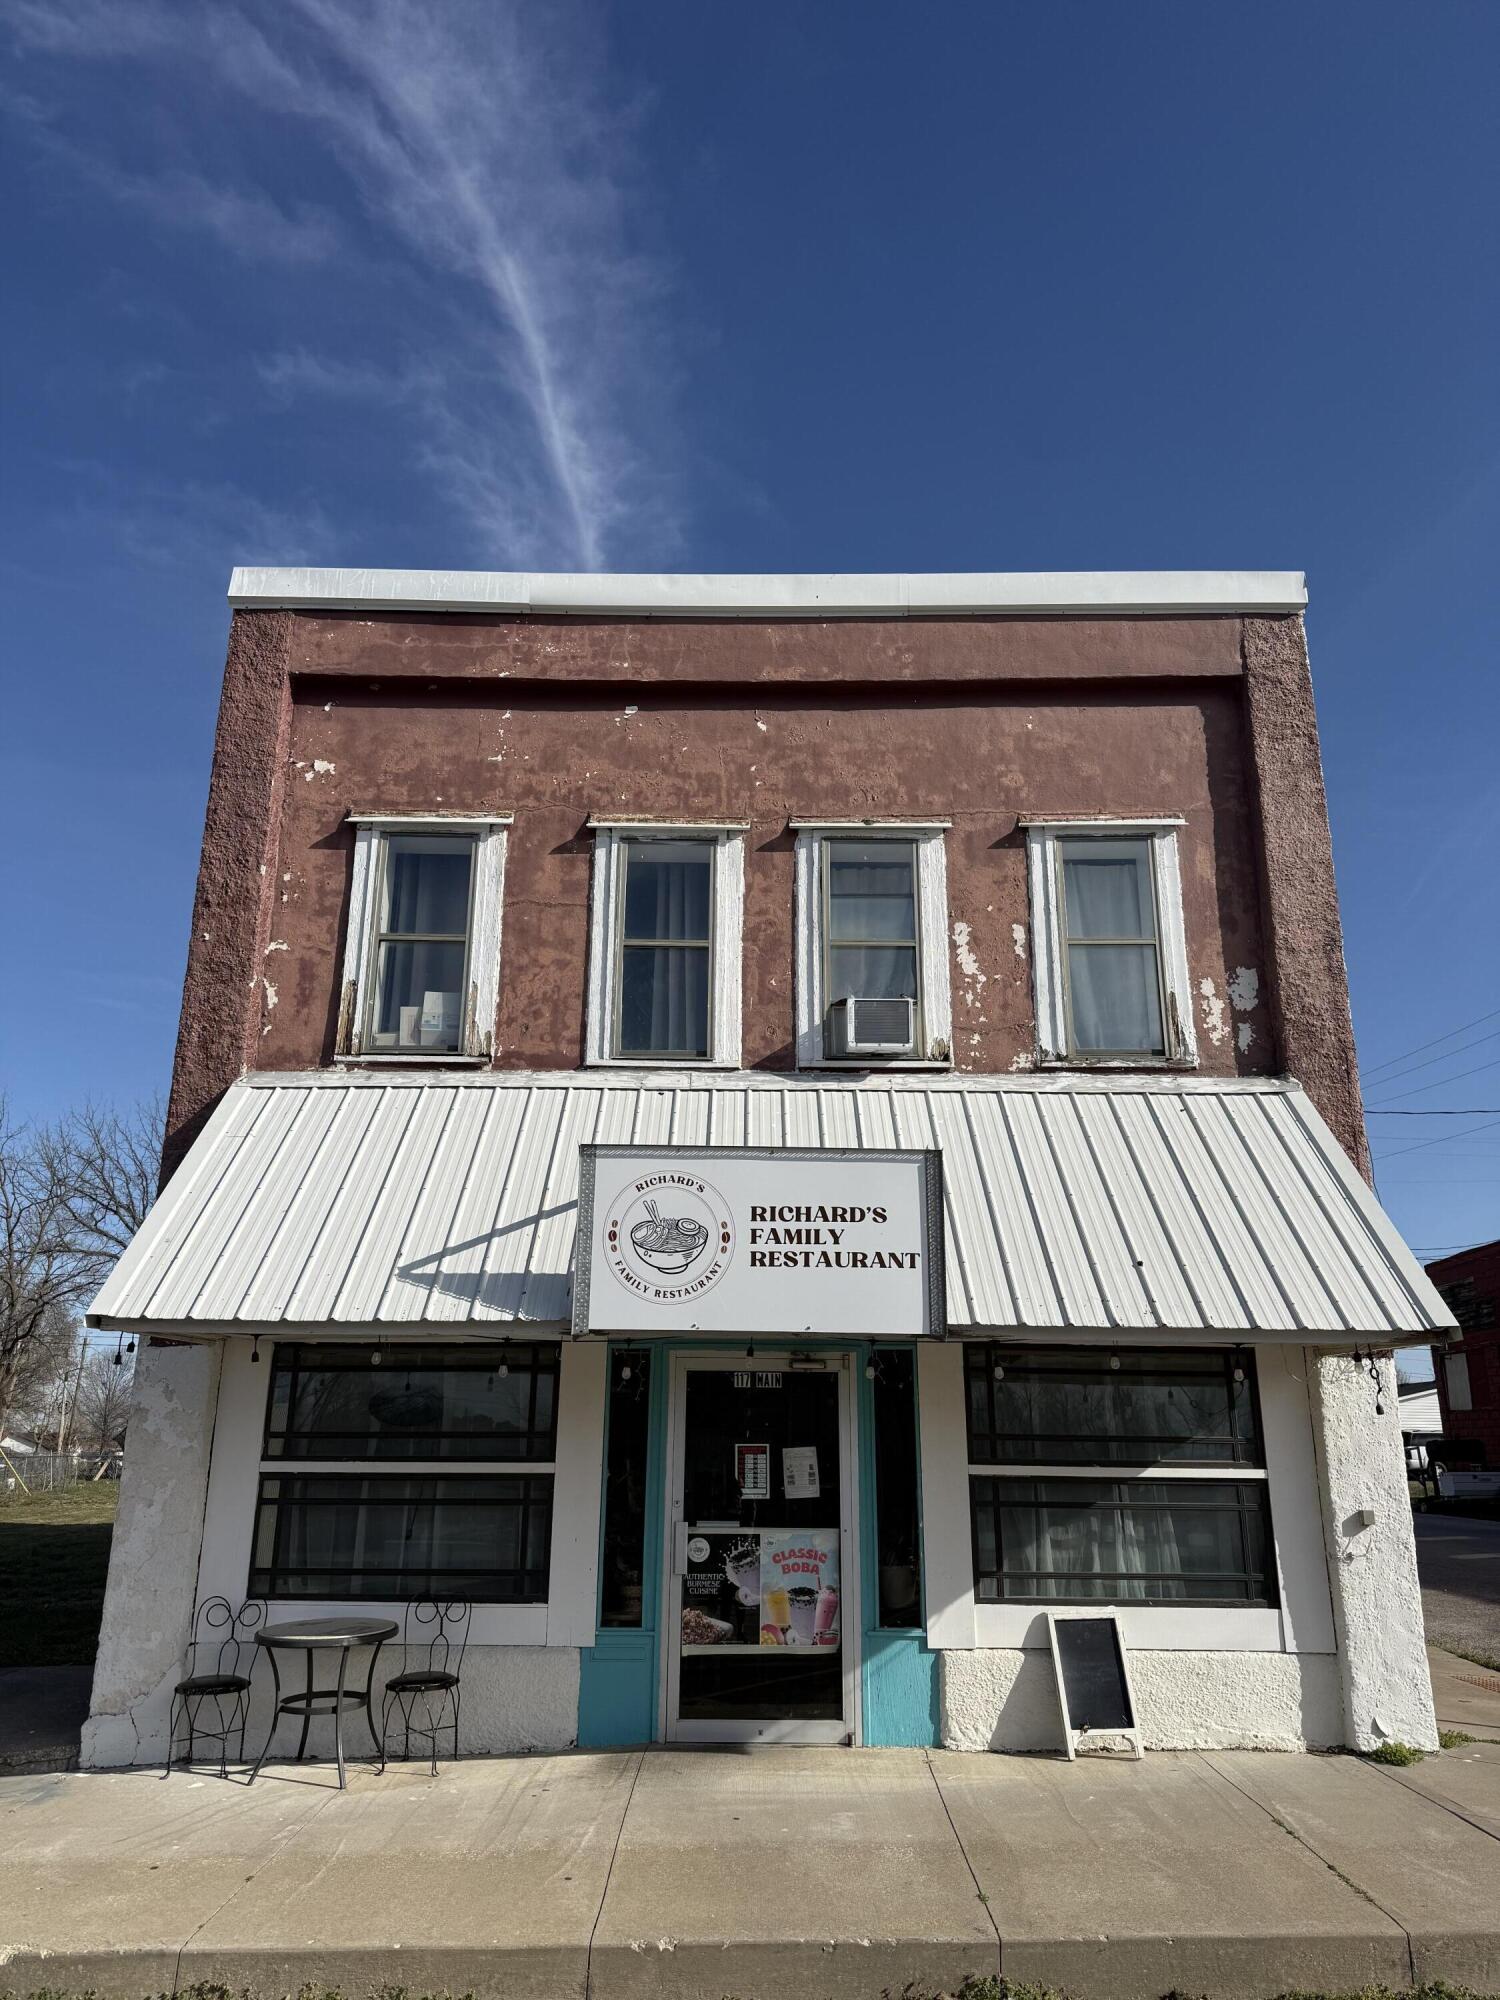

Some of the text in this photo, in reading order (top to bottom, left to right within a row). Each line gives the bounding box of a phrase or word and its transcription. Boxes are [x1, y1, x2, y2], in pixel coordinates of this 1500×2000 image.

[635, 1175, 706, 1193] RICHARD'S
[750, 1205, 888, 1224] RICHARD'S
[750, 1228, 845, 1245] FAMILY
[750, 1250, 921, 1269] RESTAURANT
[615, 1260, 722, 1299] FAMILY RESTAURANT
[735, 1372, 782, 1388] 117 MAIN
[771, 1547, 828, 1565] CLASSIC
[684, 1573, 726, 1581] AUTHENTIC
[781, 1562, 820, 1575] BOBA
[687, 1580, 721, 1588] BURMESE
[689, 1587, 719, 1595] CUISINE
